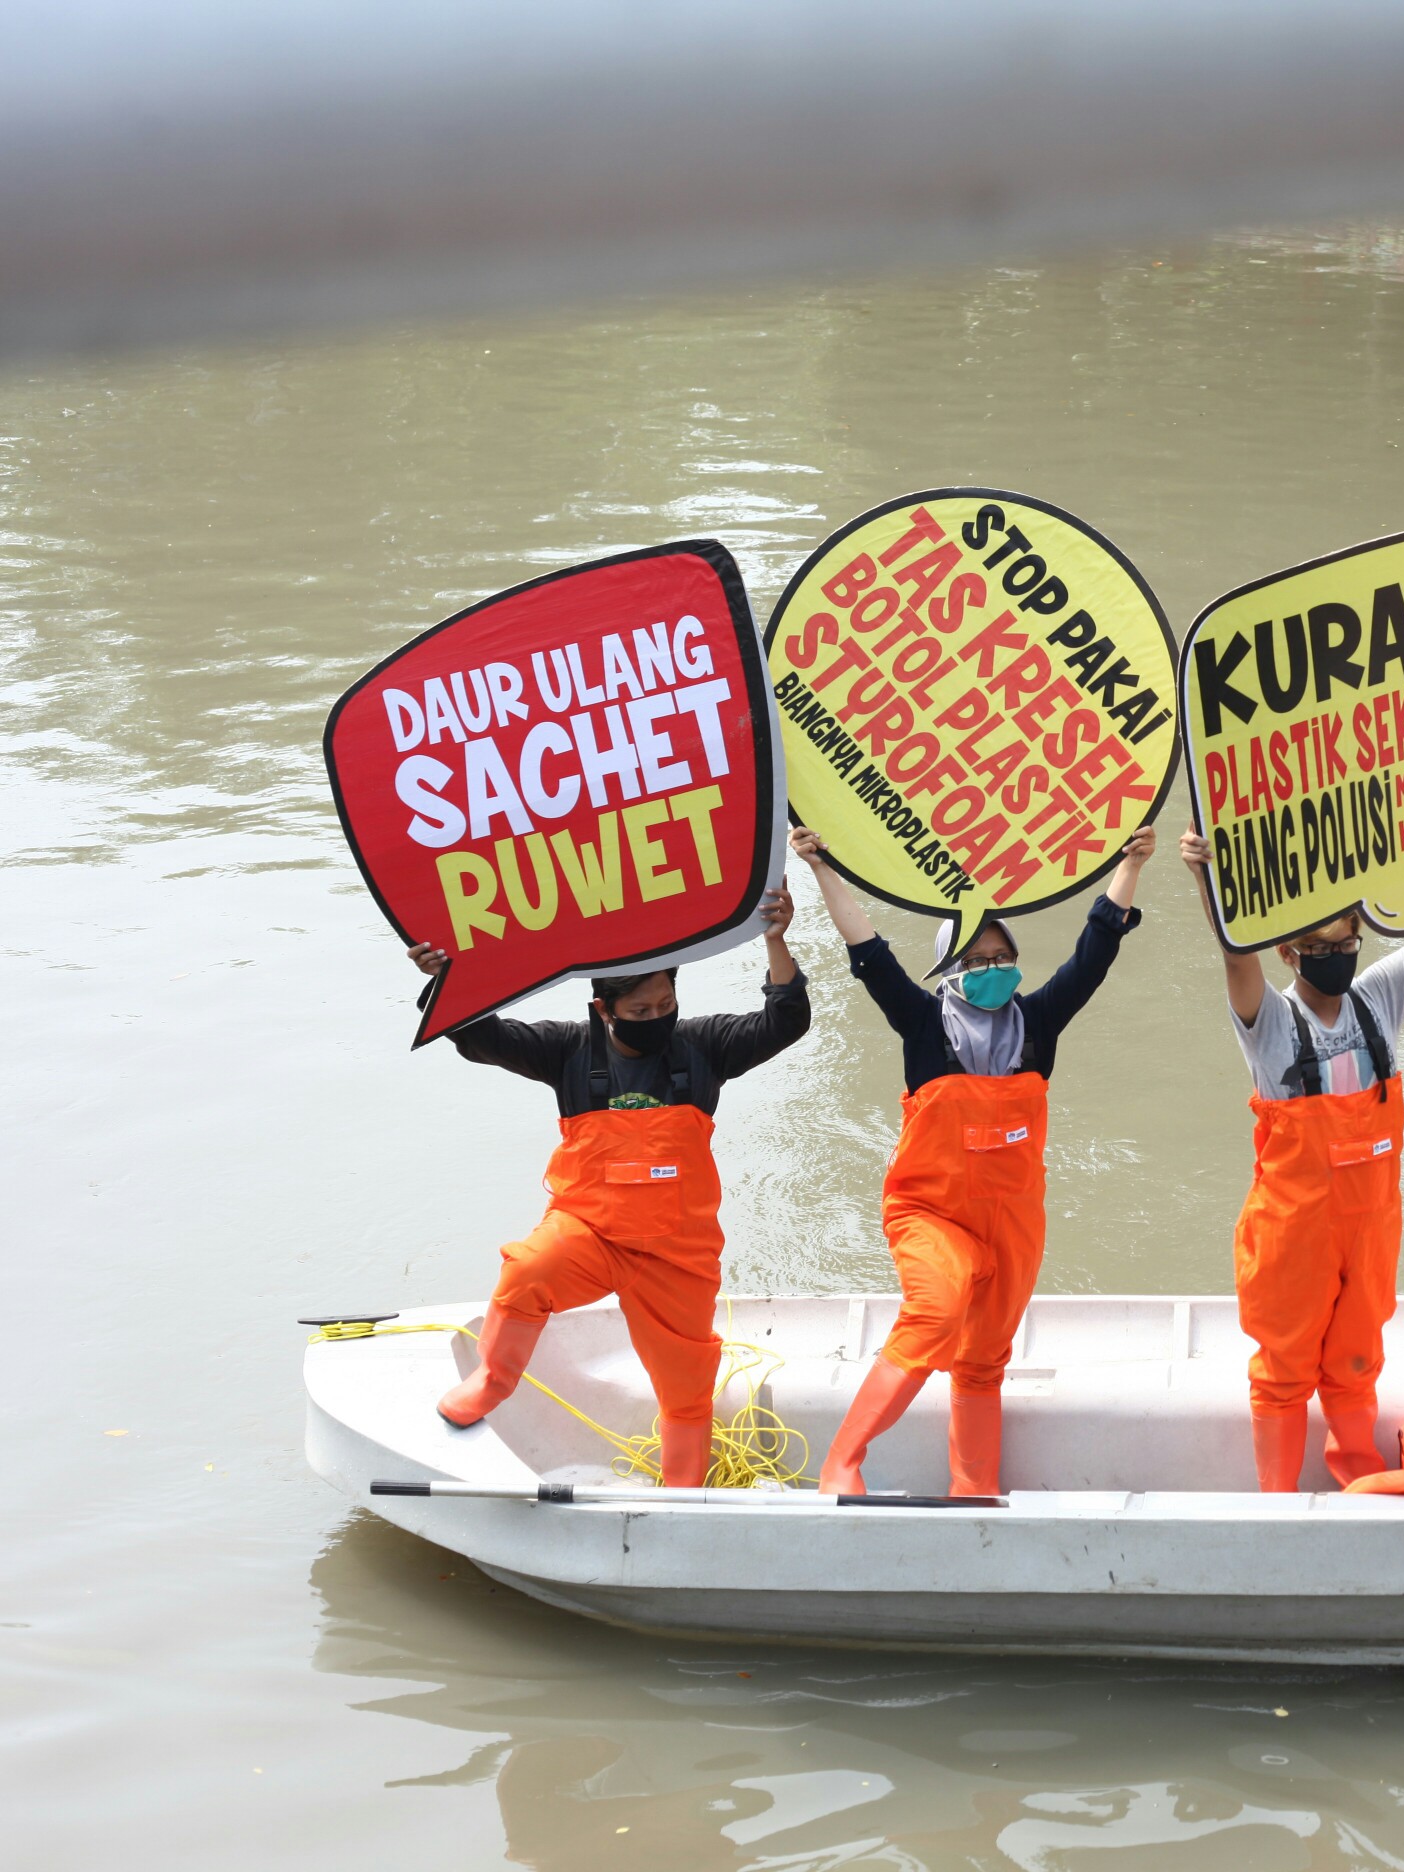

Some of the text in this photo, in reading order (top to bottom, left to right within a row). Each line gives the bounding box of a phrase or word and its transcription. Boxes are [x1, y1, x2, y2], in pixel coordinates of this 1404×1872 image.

[820, 552, 958, 711] BOTOL
[961, 503, 1069, 615] STOP
[382, 614, 715, 753] DAUR ULANG
[877, 506, 1156, 830] TAS KRESEK
[394, 677, 732, 848] SACHET
[784, 611, 1044, 907] STYROFOAM
[435, 784, 724, 952] RUWET
